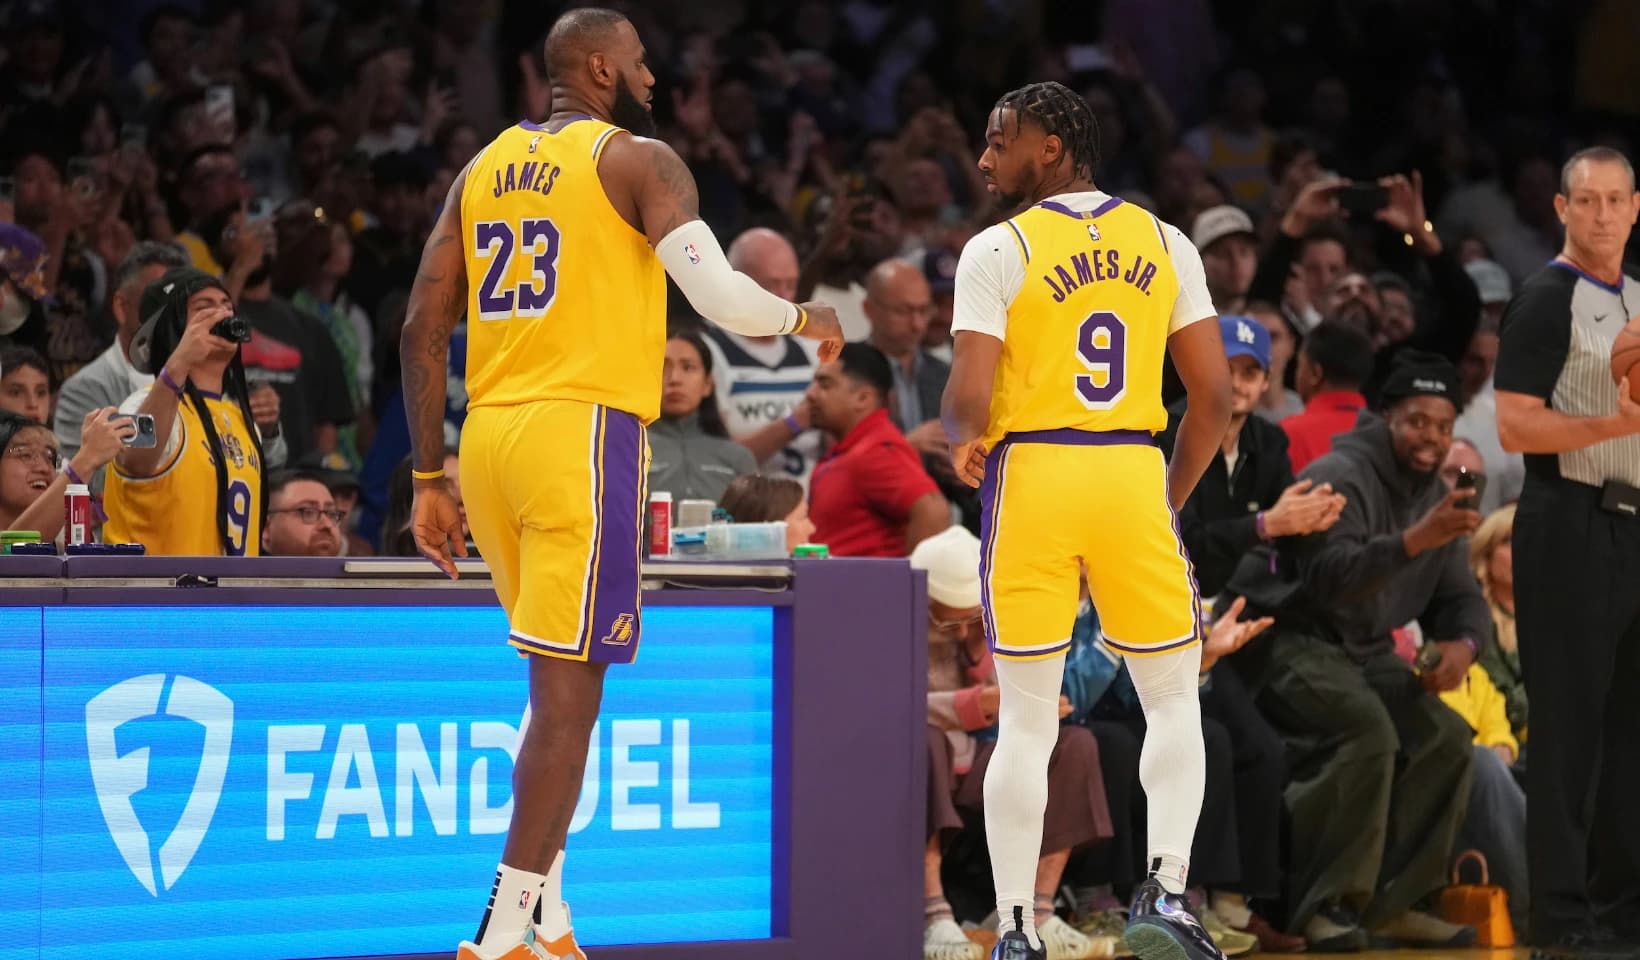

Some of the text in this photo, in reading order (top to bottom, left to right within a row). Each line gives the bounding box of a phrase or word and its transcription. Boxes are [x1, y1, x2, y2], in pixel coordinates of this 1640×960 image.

[493, 161, 561, 198] JAMES
[474, 217, 561, 321] 23
[1043, 249, 1158, 303] JAMES JR.
[1074, 310, 1128, 411] 9
[226, 478, 252, 556] 9
